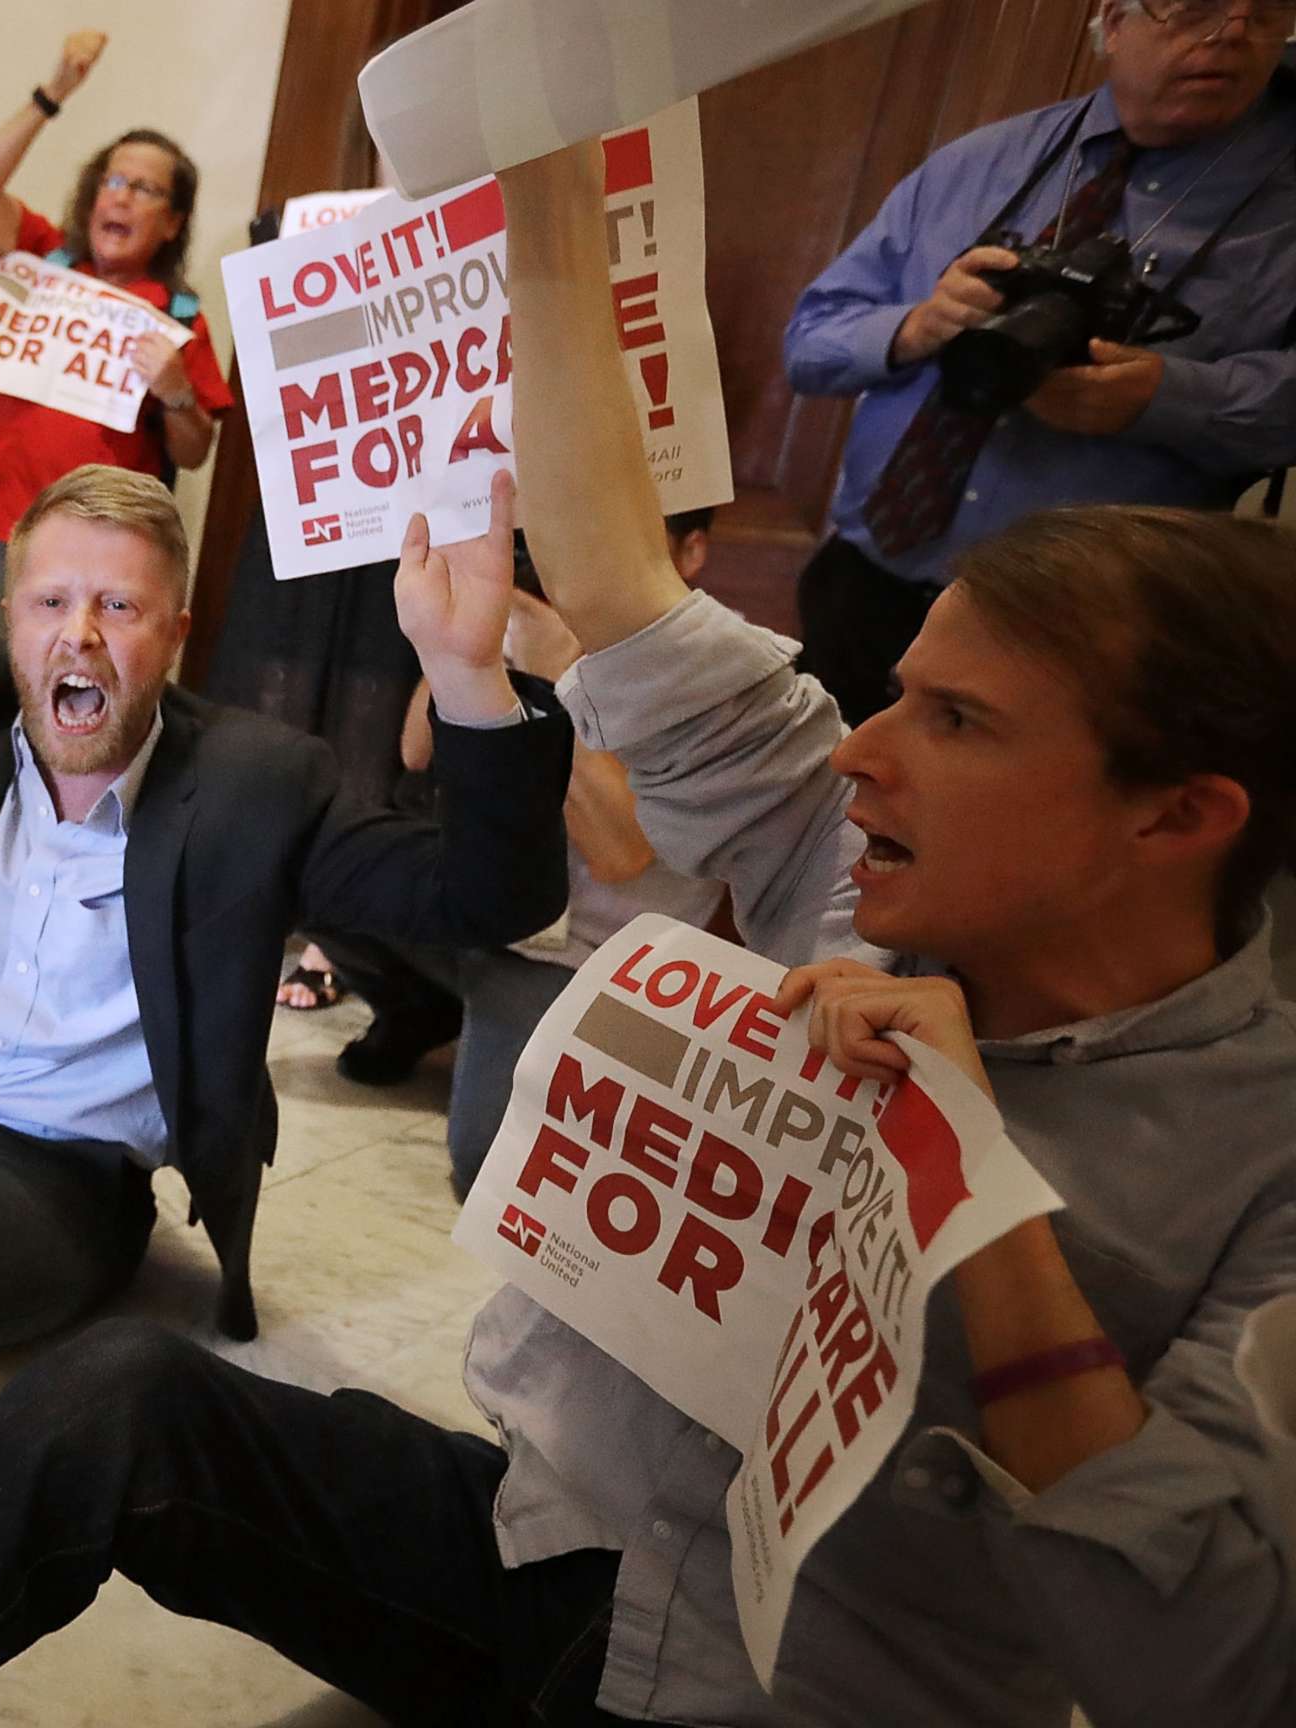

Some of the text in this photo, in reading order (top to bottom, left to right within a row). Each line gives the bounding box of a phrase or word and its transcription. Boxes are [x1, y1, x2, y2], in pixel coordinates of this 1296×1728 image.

[298, 204, 368, 230] LOV
[259, 210, 446, 321] LOVE IT!
[290, 413, 424, 506] FOR
[344, 501, 391, 518] National
[347, 524, 384, 541] United
[609, 943, 791, 1062] LOVE
[681, 1046, 895, 1272] IMPROVE
[516, 1123, 745, 1326] FOR
[545, 1053, 899, 1450] MEDICARE
[550, 1231, 601, 1273] National
[540, 1255, 580, 1288] United
[545, 1243, 584, 1277] Nurses
